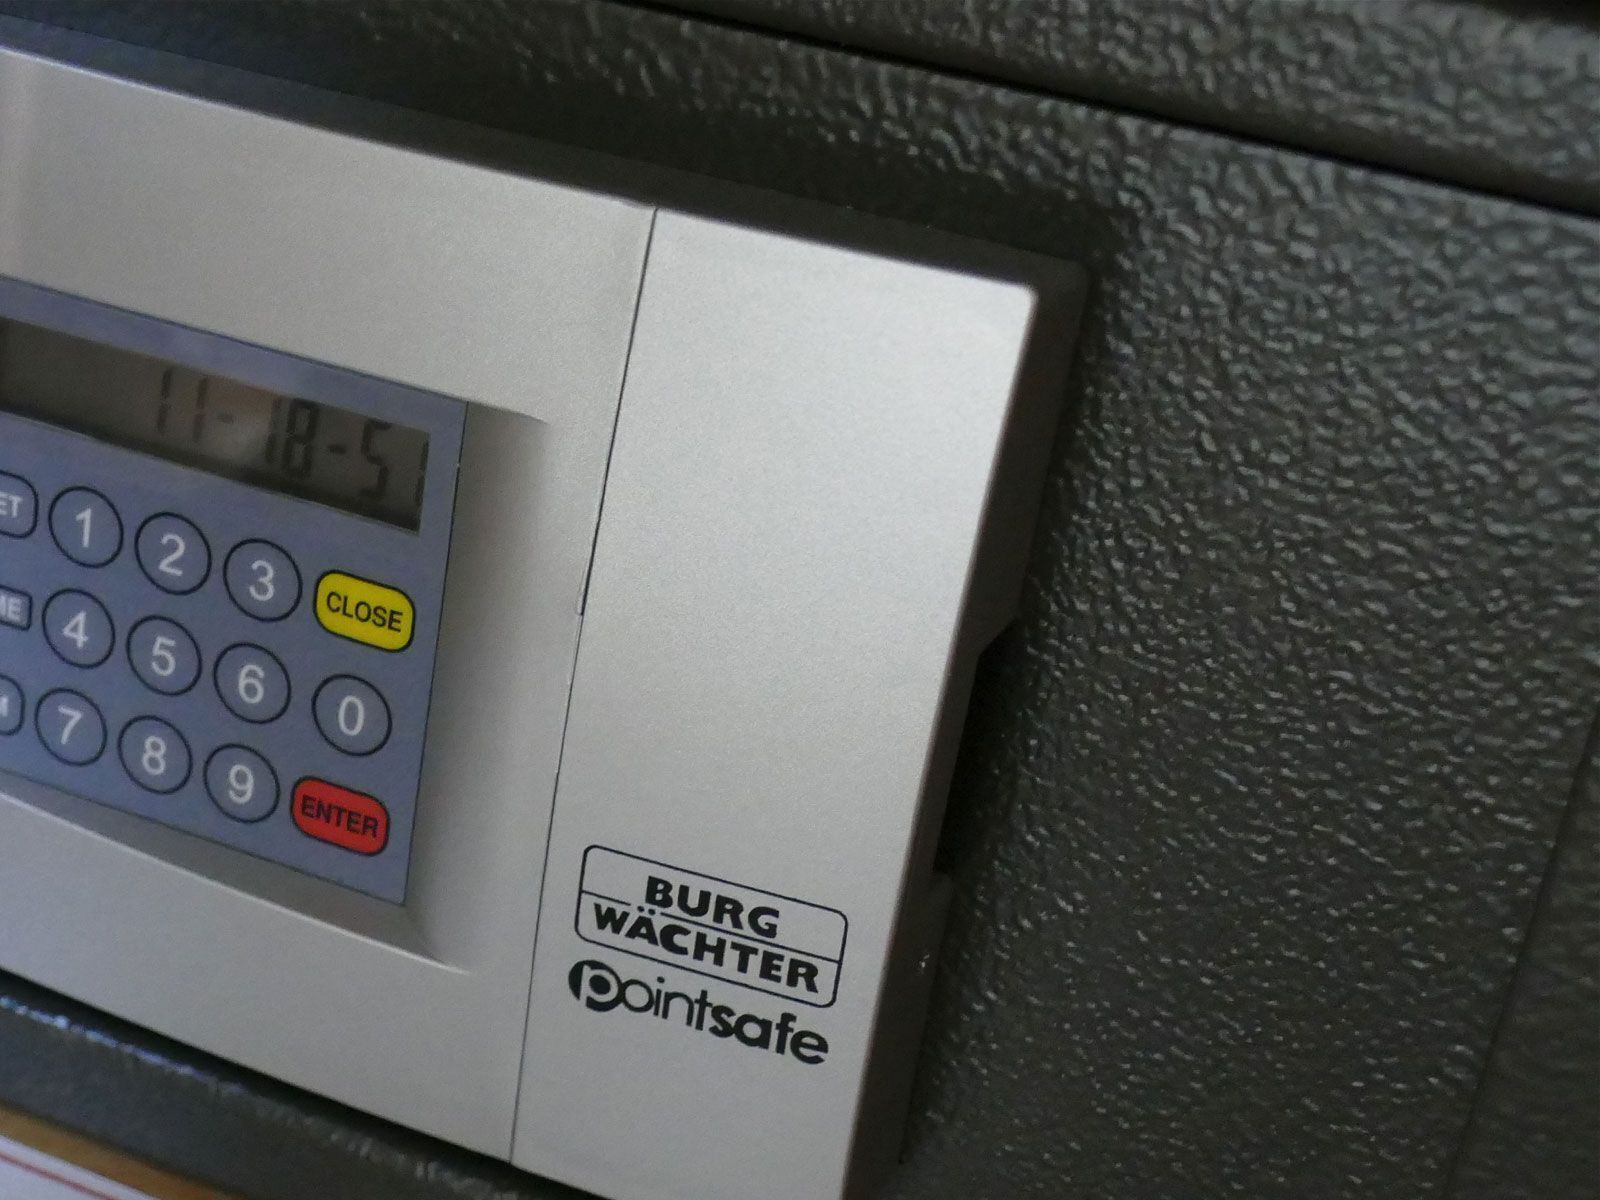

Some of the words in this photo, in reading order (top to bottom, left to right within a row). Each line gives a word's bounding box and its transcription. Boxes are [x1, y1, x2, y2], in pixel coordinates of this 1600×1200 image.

[76, 508, 92, 547] 1
[160, 534, 184, 576] 2
[249, 560, 275, 601] 3
[62, 611, 89, 648] 4
[327, 593, 403, 632] CLOSE
[152, 637, 176, 676] 5
[238, 664, 264, 704] 6
[58, 706, 83, 745] 7
[337, 696, 365, 737] 0
[143, 736, 166, 776] 8
[228, 764, 254, 804] 9
[301, 796, 379, 839] ENTER
[645, 875, 780, 938] BURG
[594, 902, 819, 993] WÄCHTER
[568, 959, 829, 1064] pointsafe
